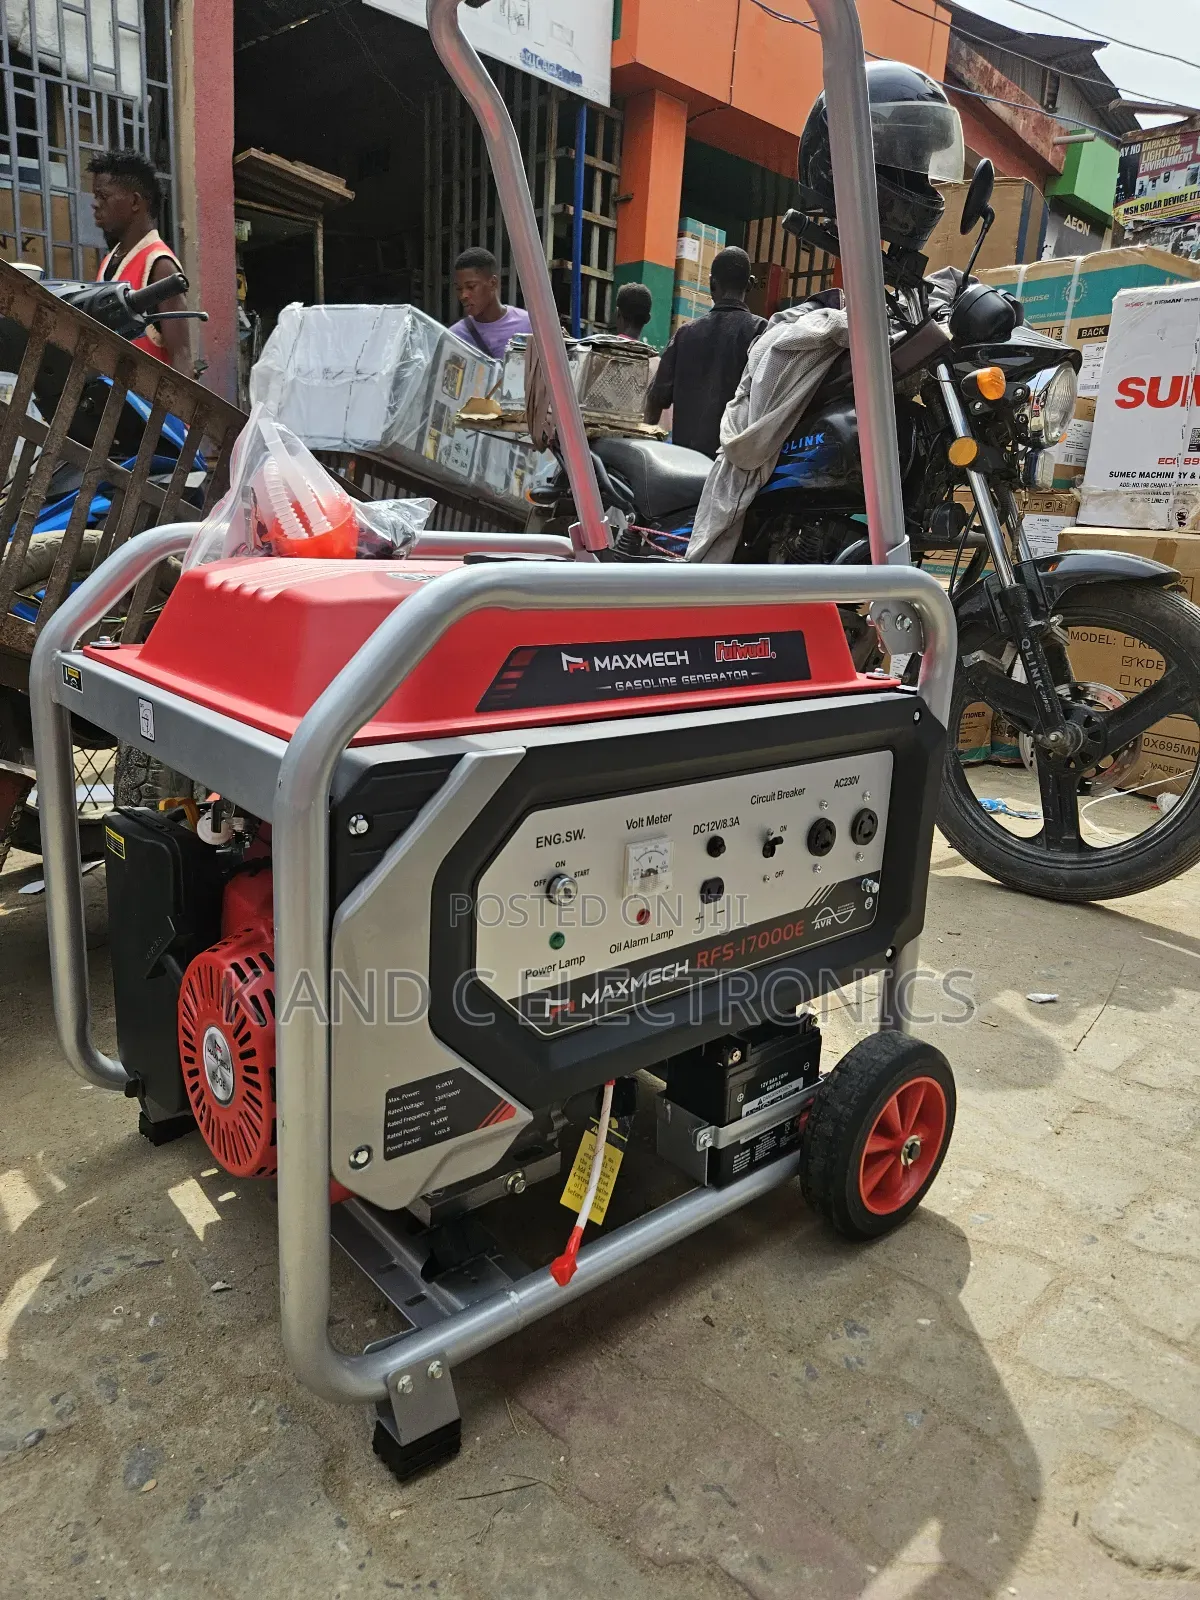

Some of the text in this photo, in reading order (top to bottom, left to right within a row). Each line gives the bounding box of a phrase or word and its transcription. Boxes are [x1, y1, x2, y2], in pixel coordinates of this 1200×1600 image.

[1130, 144, 1141, 154] NO
[1142, 135, 1181, 152] DARKNESS
[1142, 146, 1168, 163] LIGHT
[1168, 143, 1181, 156] UP
[1139, 151, 1194, 174] ENVIRONMENT
[1123, 204, 1140, 215] MSN
[1140, 199, 1161, 212] SOLAR
[1163, 192, 1188, 207] DEVICE
[1064, 214, 1091, 236] AEON
[1081, 327, 1106, 338] BACK
[1109, 471, 1137, 479] SUMEC
[1070, 630, 1116, 646] MODEL:
[594, 650, 690, 672] MAXMECH
[1021, 638, 1044, 690] QLINK
[1136, 658, 1165, 671] KDE
[615, 669, 749, 692] GASOLINE GENERATOR
[1150, 762, 1174, 774] MADE
[833, 774, 861, 789] AC230V
[750, 786, 806, 806] Circuit Breaker
[626, 812, 673, 831] Volt Meter
[692, 816, 741, 836] DC12V/8.3A
[779, 824, 788, 833] ON
[535, 827, 587, 849] ENG.SW.
[555, 860, 566, 869] ON
[573, 868, 590, 878] START
[774, 869, 785, 879] OFF
[533, 878, 548, 888] OFF
[814, 917, 832, 931] AVR
[609, 928, 674, 955] Oil Alarm Lamp
[525, 954, 586, 981] Power Lamp
[581, 919, 806, 1010] MAXMECH RFS-17000E
[387, 1096, 402, 1104] Max.
[401, 1090, 421, 1100] Power:
[387, 1107, 404, 1116] Rated
[403, 1100, 425, 1111] Voltage:
[387, 1118, 404, 1128] Rated
[403, 1110, 431, 1123] Frequency:
[386, 1130, 403, 1140] Rated
[402, 1125, 421, 1135] Power:
[386, 1142, 403, 1153] Power
[403, 1136, 422, 1147] Factor:
